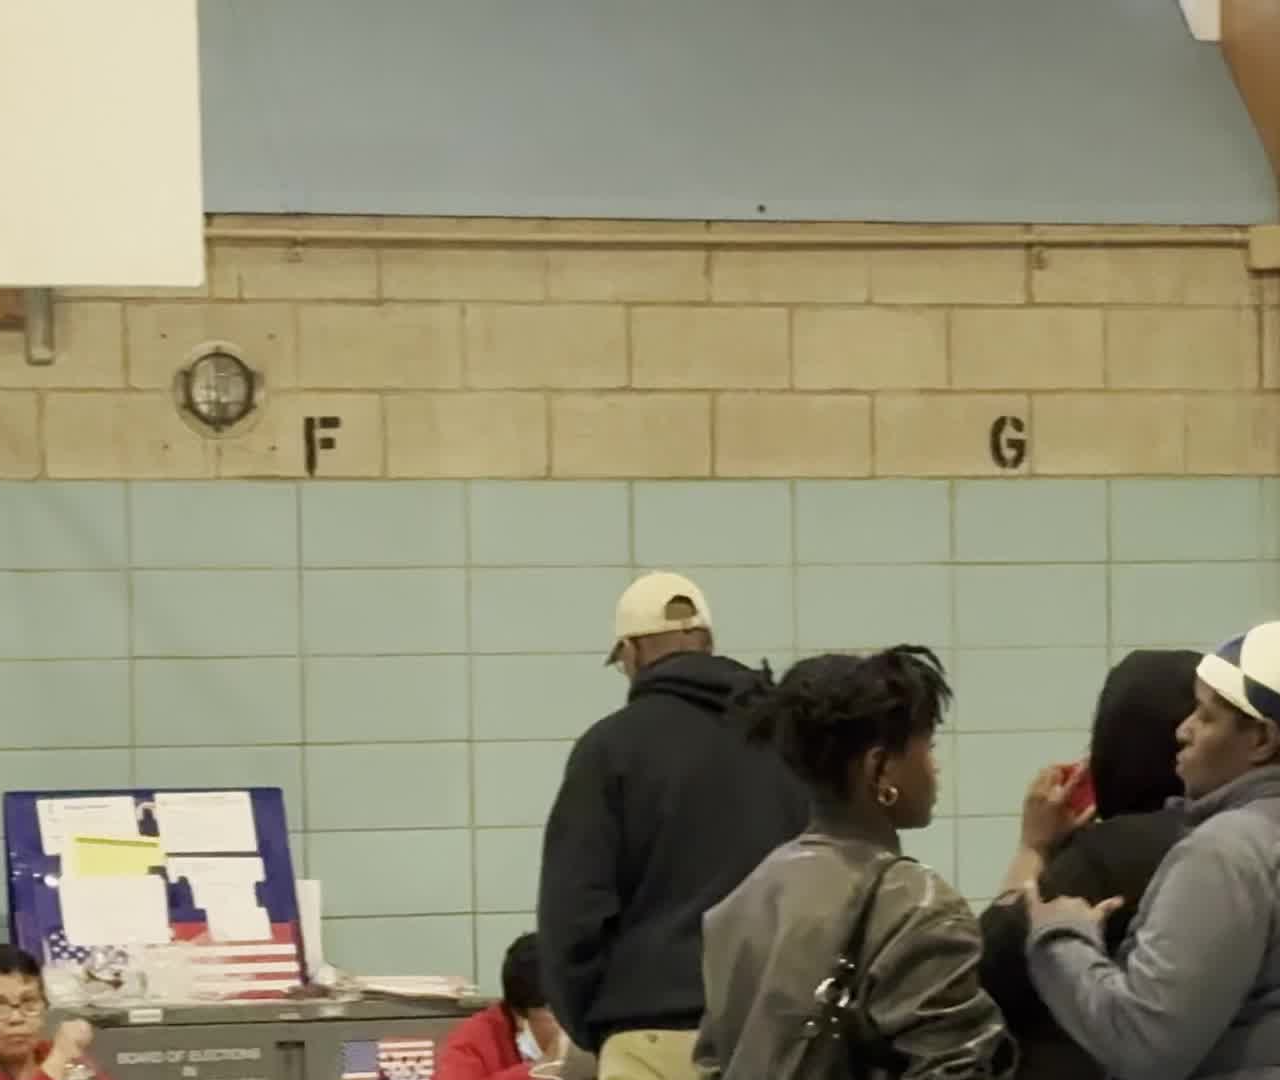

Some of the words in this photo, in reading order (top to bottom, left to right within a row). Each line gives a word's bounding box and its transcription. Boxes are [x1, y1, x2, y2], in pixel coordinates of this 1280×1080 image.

[304, 416, 340, 477] F
[991, 416, 1026, 469] G
[117, 1052, 163, 1064] BOARD
[167, 1050, 186, 1063] OF
[188, 1048, 260, 1062] ELECTIONS
